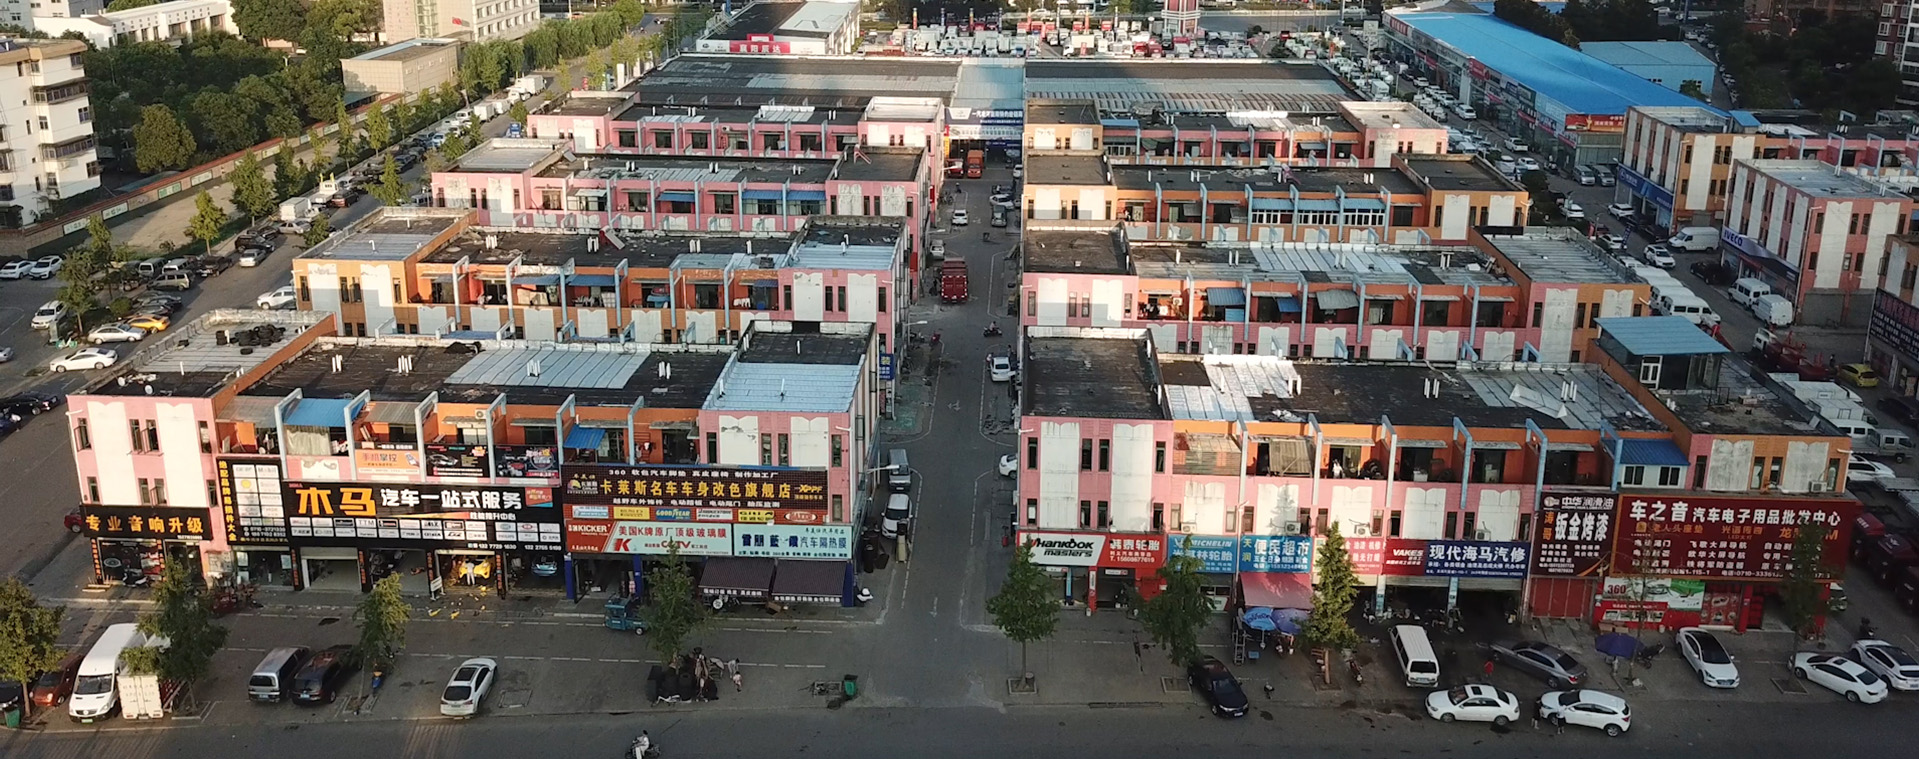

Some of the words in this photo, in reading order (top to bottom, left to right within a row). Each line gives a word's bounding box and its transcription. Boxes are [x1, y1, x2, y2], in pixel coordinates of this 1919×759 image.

[1724, 229, 1743, 247] IVECO
[600, 478, 791, 499] 卡莱斯名车车身改色旗舰店
[295, 486, 377, 517] 木马
[380, 488, 523, 511] 汽车一站式服务
[1561, 496, 1615, 508] 中华润滑油
[655, 507, 691, 517] GOODYEAR
[1629, 499, 1689, 522] 车之音
[1692, 506, 1841, 527] 汽车电子用品批发中心
[85, 514, 204, 534] 专业音响升级
[577, 524, 608, 533] KICKER
[1554, 511, 1610, 542] 钣金烤漆
[619, 526, 727, 539] 美国K牌原厂顶级玻璃膜
[613, 538, 632, 552] K
[800, 536, 847, 549] 汽车隔热膜
[1036, 538, 1095, 550] Hankook
[1110, 538, 1160, 551] 韩泰轮胎
[1191, 539, 1233, 548] MICHELIN
[1254, 538, 1310, 557] 便民超市
[1689, 540, 1748, 550] 飞歌大屏导航
[1043, 549, 1094, 558] masters
[1393, 549, 1424, 557] VAKES
[1429, 544, 1526, 562] 现代海马汽修
[1607, 584, 1627, 595] 360
